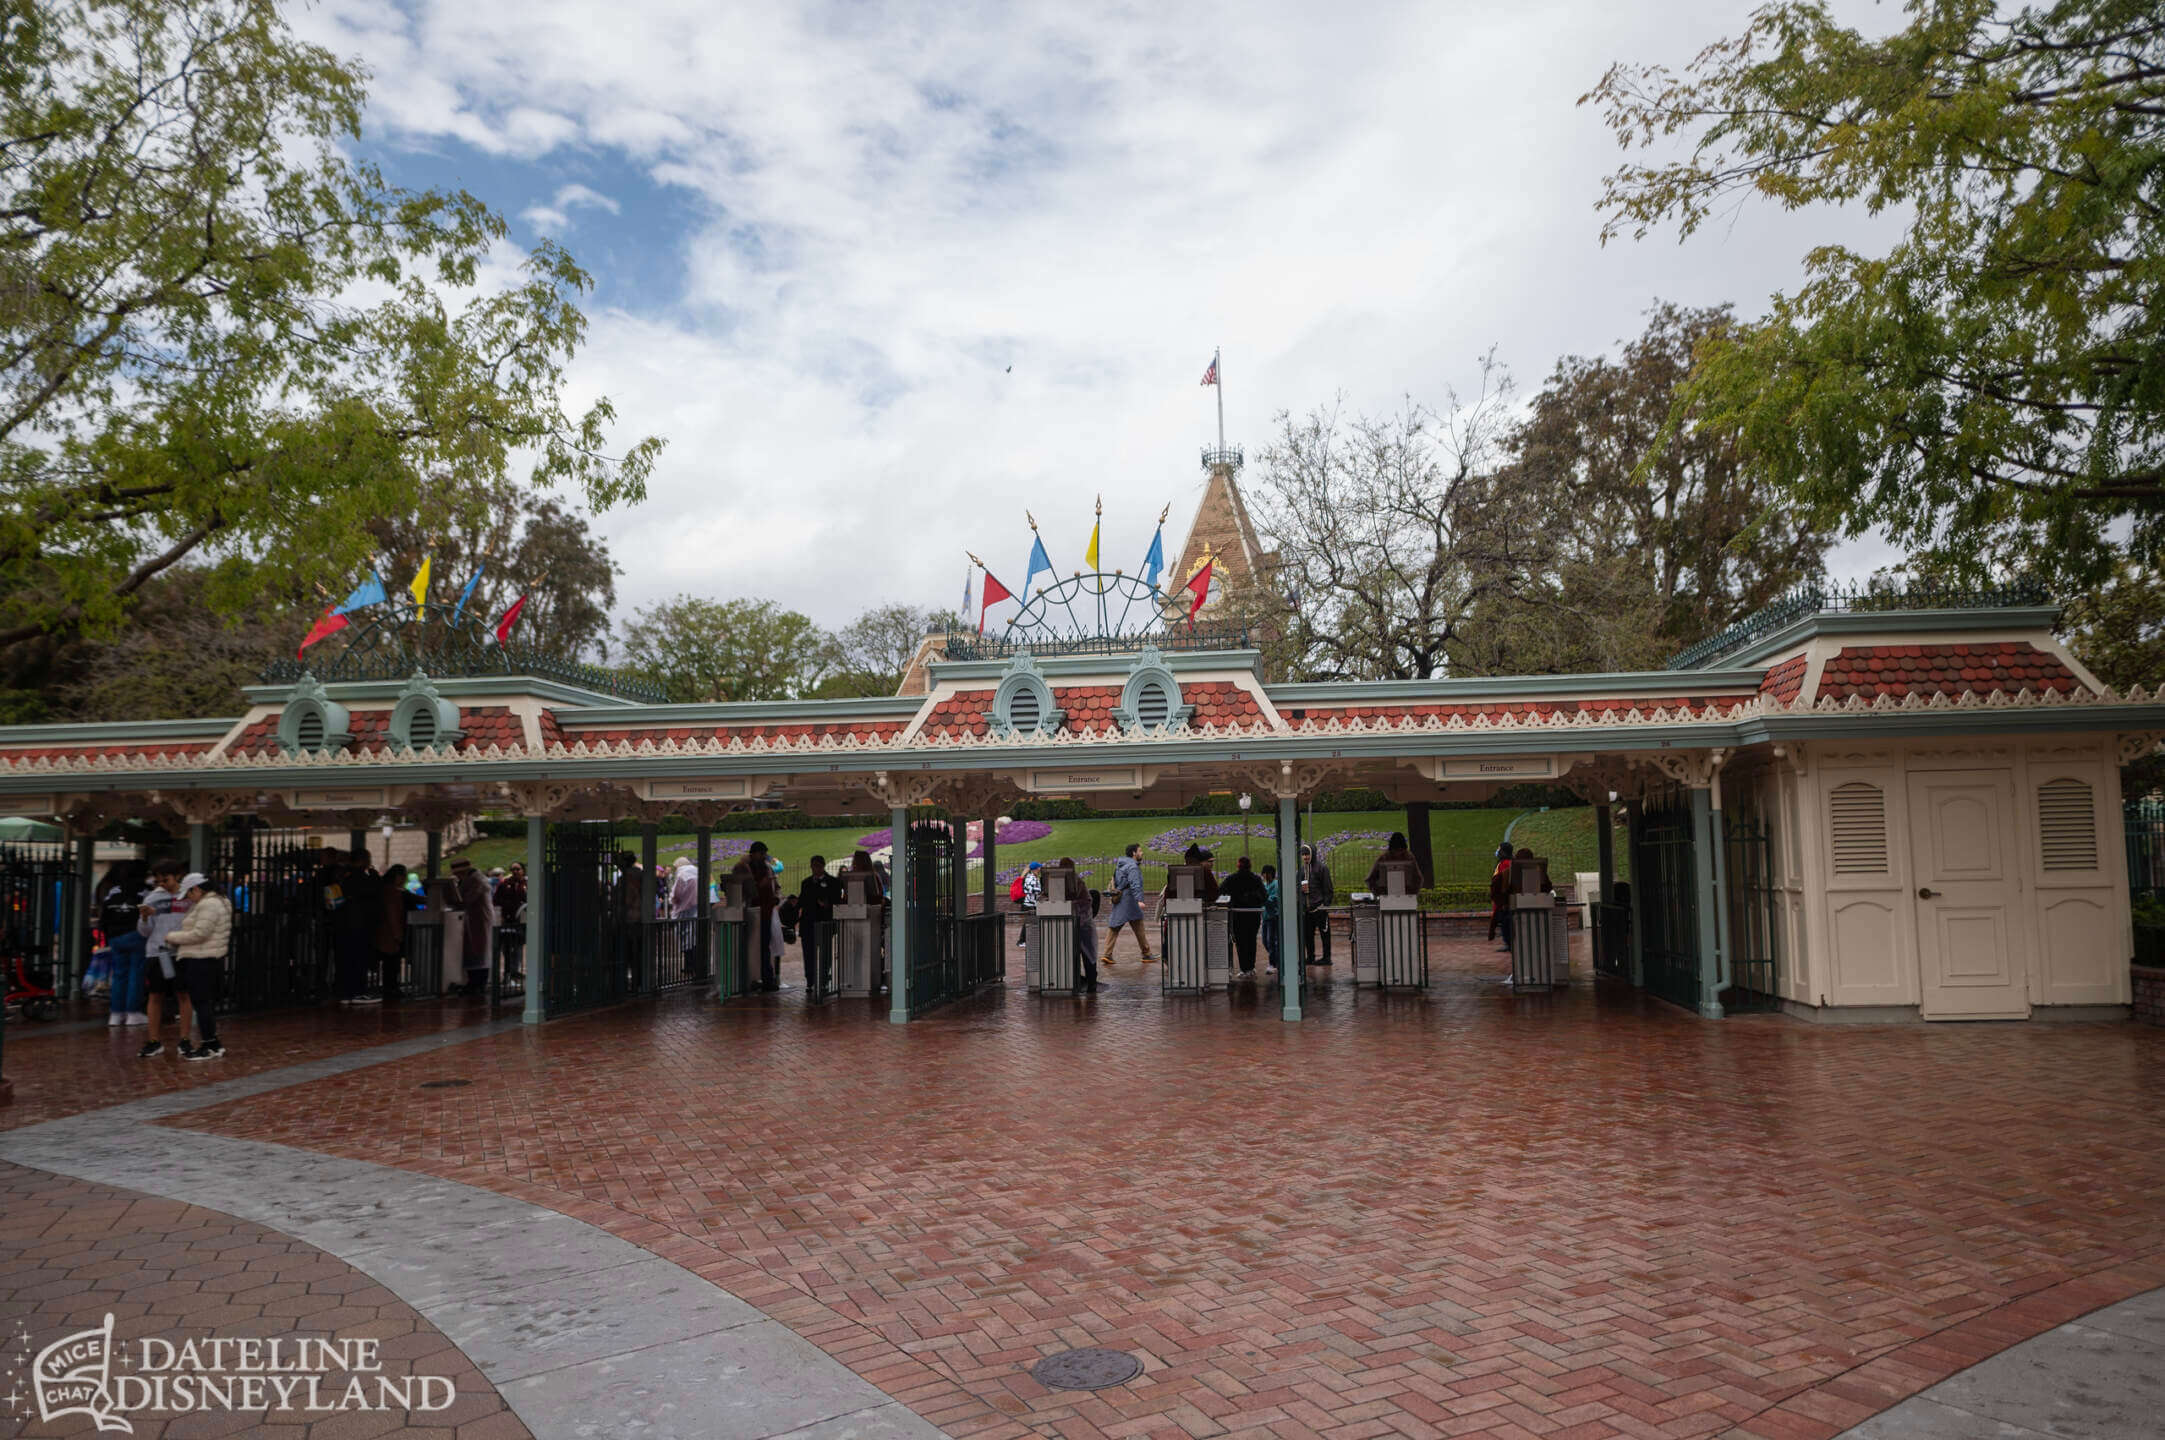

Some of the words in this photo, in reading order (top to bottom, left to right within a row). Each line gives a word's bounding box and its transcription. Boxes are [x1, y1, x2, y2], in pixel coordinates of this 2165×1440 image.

[1479, 763, 1514, 772] Entrance
[1067, 775, 1101, 784] Entrance
[682, 784, 713, 793] Entrance
